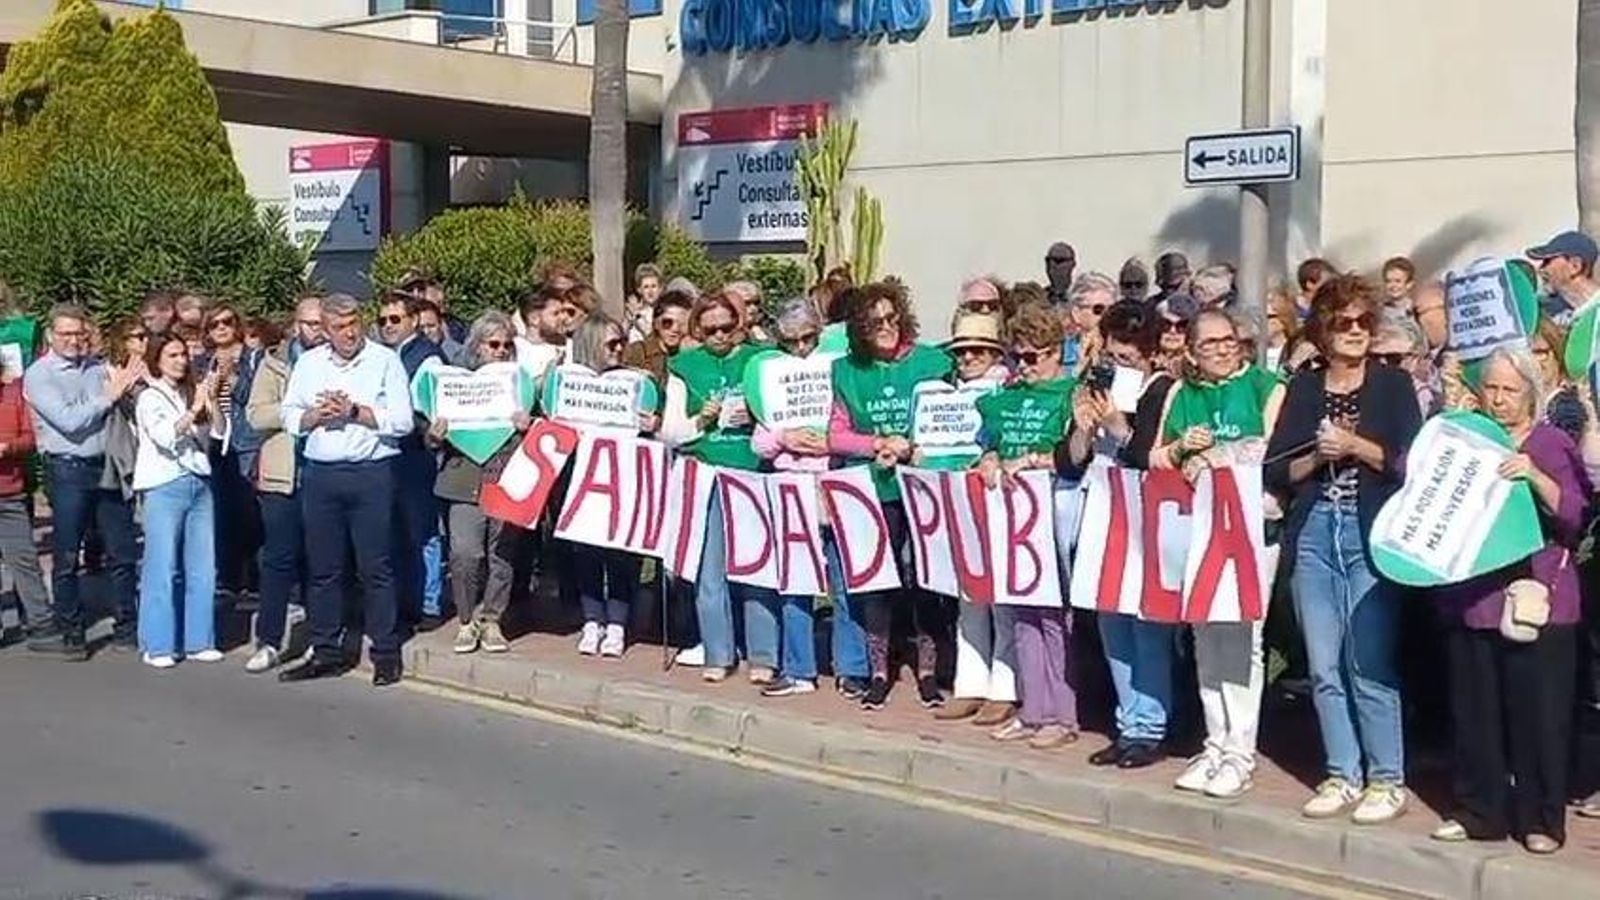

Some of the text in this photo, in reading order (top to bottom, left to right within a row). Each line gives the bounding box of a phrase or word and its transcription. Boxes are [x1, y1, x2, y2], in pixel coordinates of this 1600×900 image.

[736, 148, 799, 173] Vestíbul
[1226, 146, 1288, 166] SALIDA
[738, 180, 800, 203] Consulta
[748, 209, 809, 229] externas
[480, 420, 889, 592] SANIDAD
